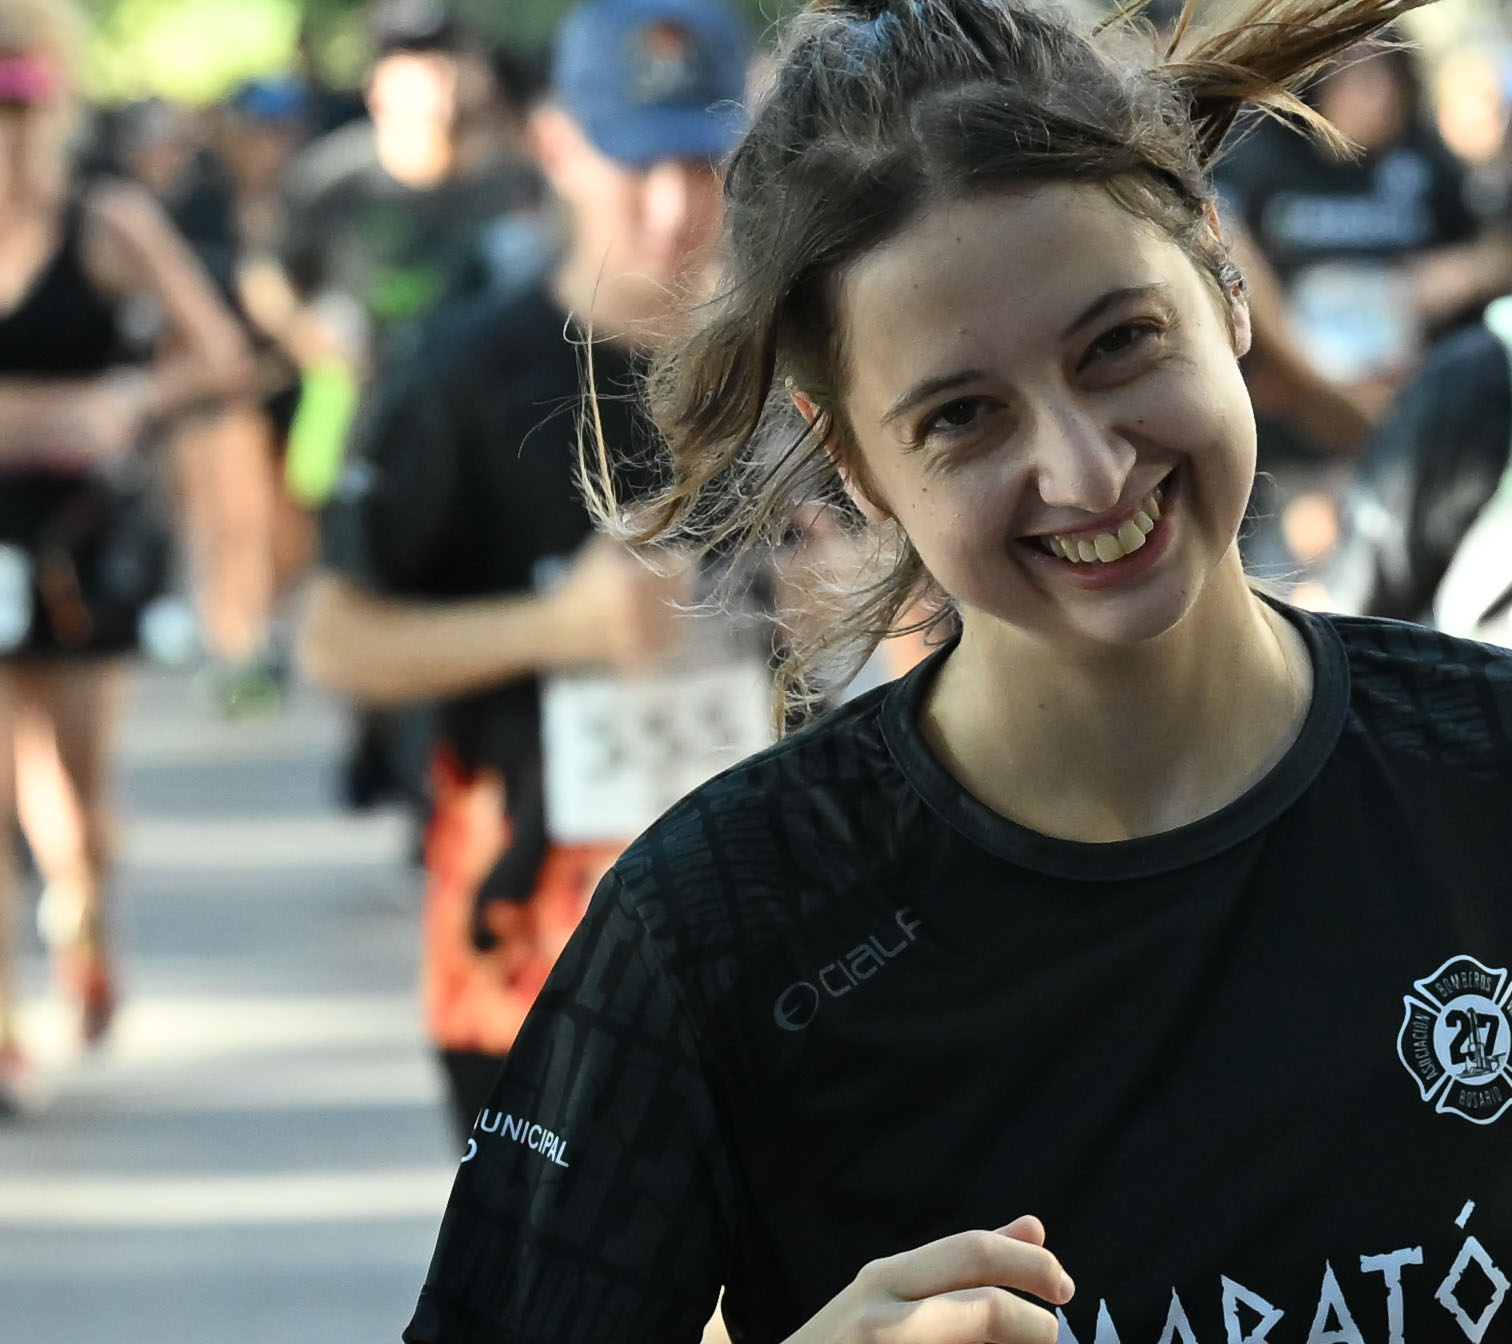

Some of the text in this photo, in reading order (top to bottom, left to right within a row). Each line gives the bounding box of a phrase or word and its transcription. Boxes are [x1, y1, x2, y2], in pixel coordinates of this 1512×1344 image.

[1435, 971, 1492, 997] BOMBEROS
[1445, 1009, 1500, 1065] 27
[1459, 1086, 1502, 1108] ROSARIO
[472, 1107, 569, 1168] UNICIPAL
